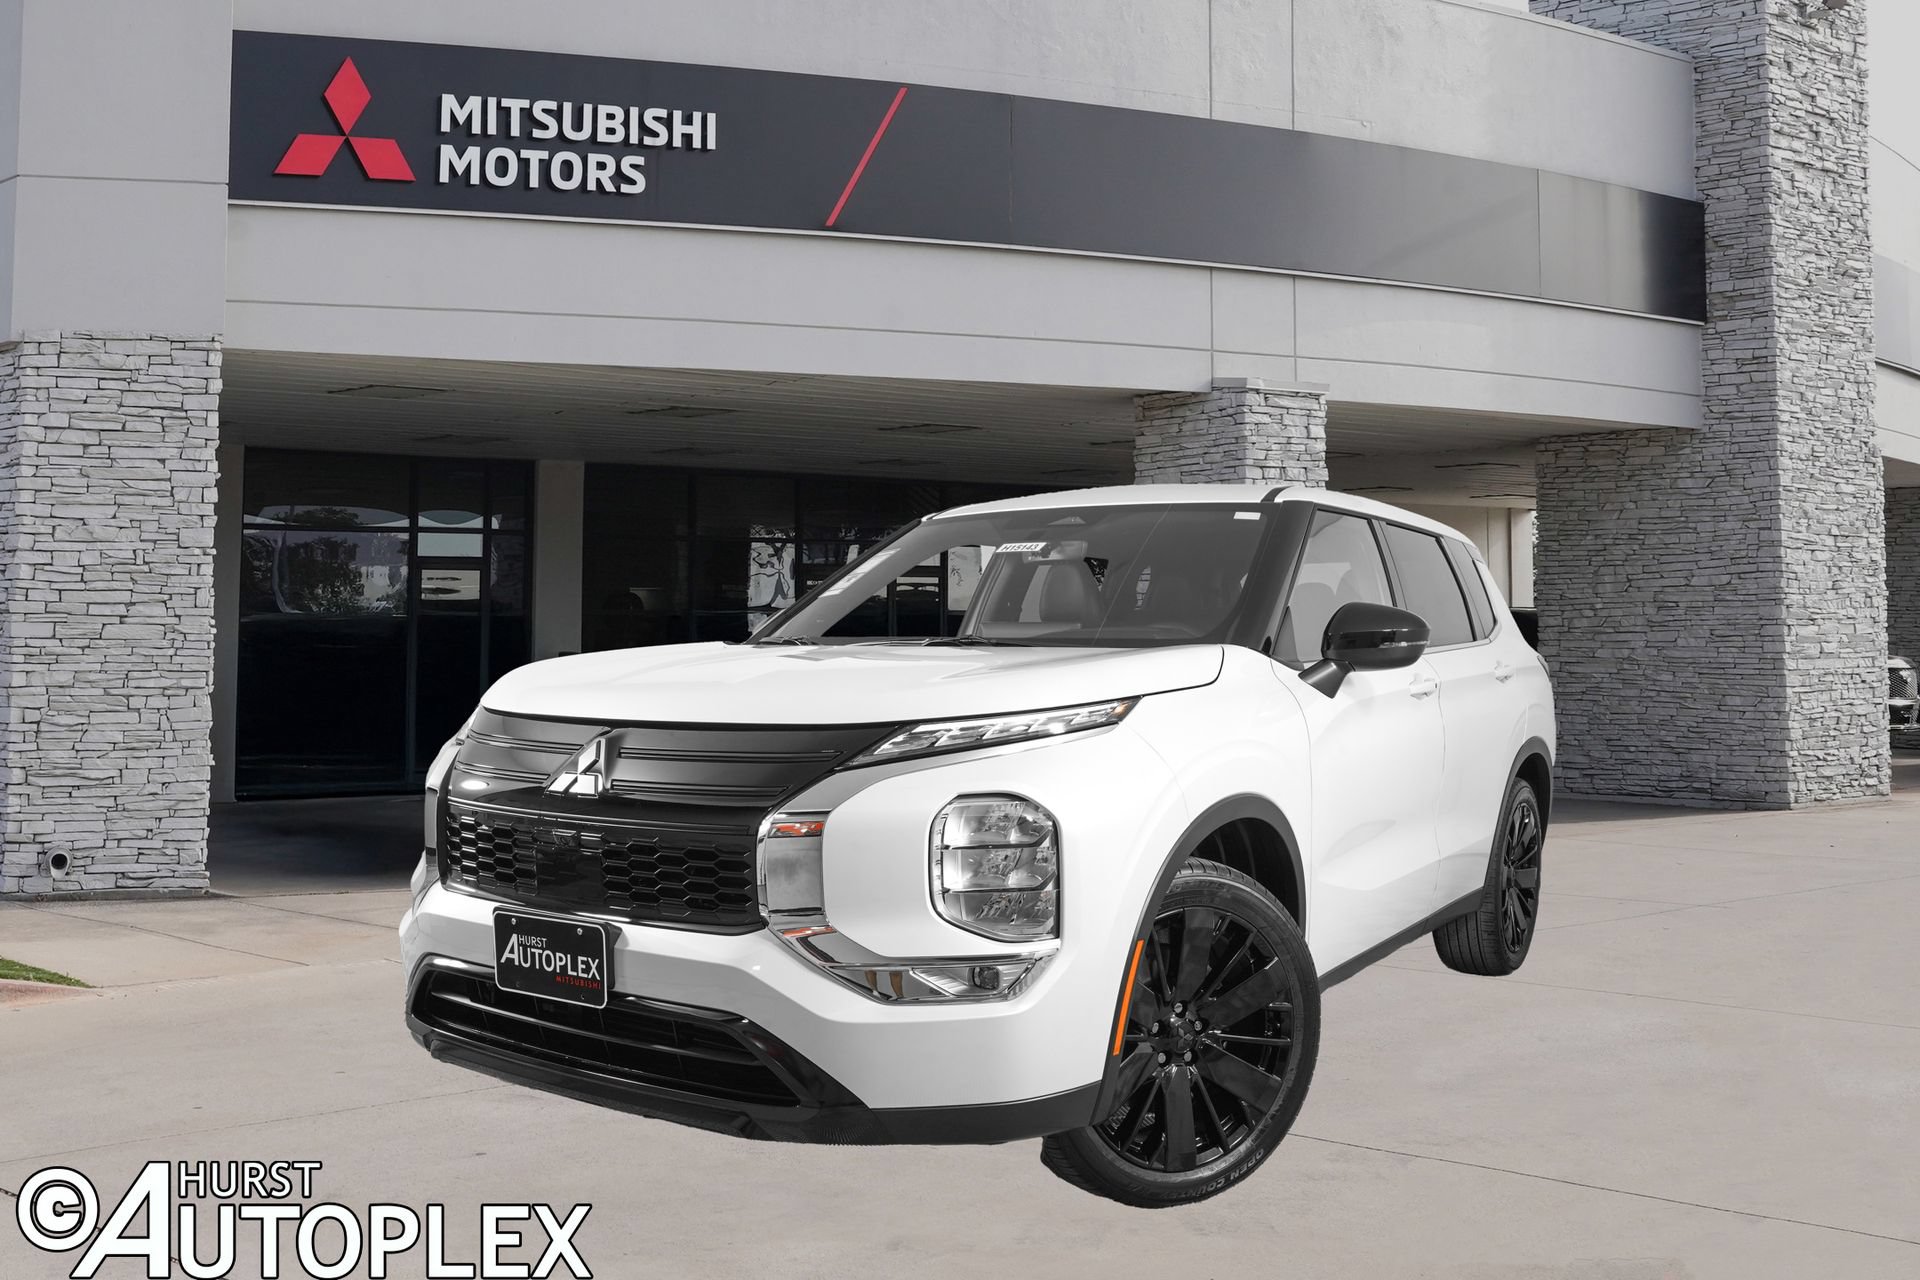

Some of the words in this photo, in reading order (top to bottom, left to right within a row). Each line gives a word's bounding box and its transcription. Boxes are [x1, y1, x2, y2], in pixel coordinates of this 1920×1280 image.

[439, 93, 717, 151] MITSUBISHI
[438, 144, 646, 194] MOTORS
[500, 933, 601, 981] AUTOPLEX
[518, 934, 547, 948] HURST
[555, 975, 601, 989] MITSUBISHI
[1230, 1148, 1265, 1181] OPEN
